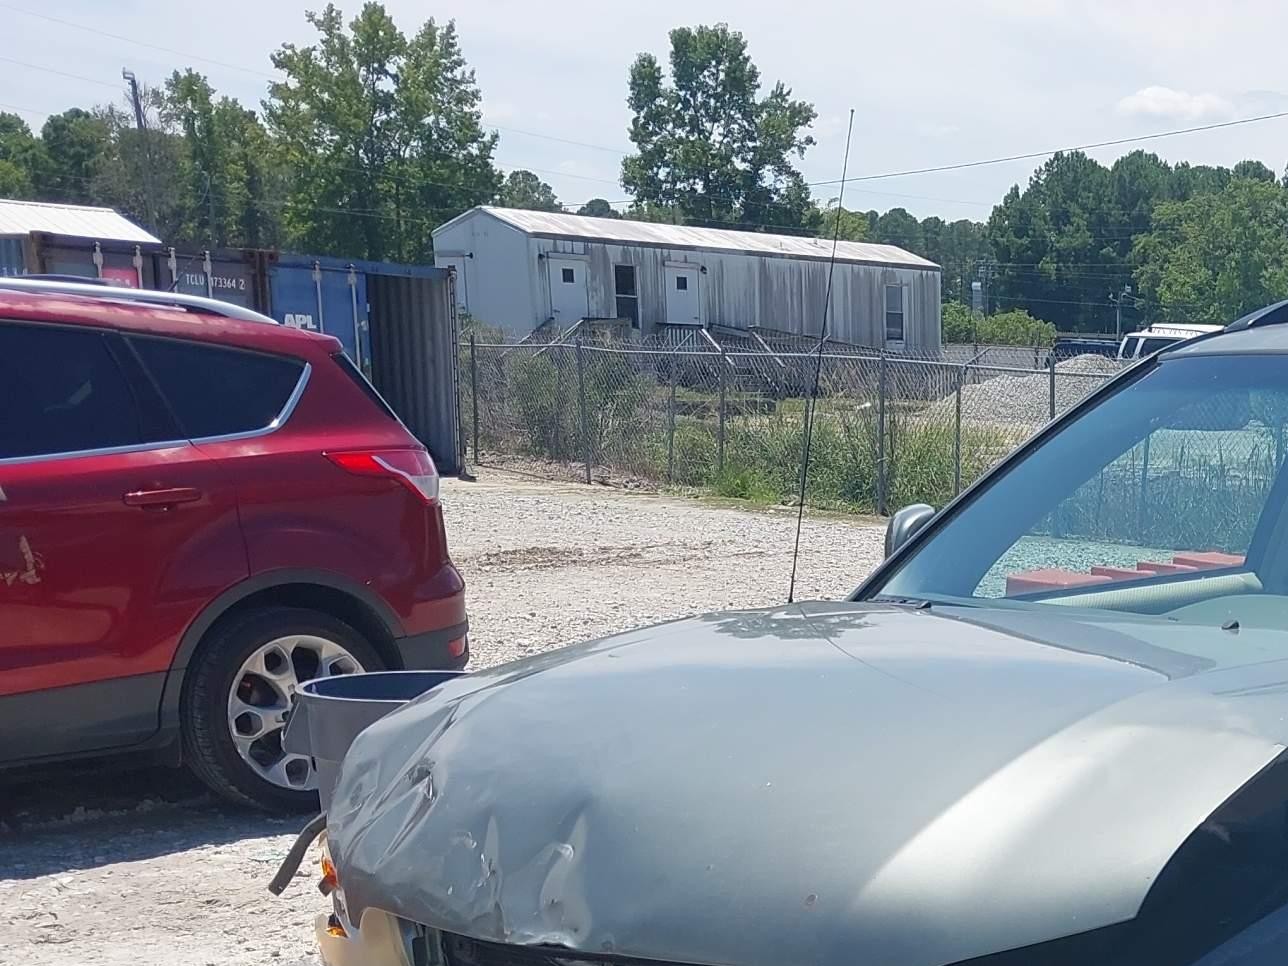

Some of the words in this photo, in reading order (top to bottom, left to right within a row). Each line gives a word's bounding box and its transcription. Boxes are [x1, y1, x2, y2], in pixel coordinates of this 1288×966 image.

[186, 273, 205, 286] TCLU
[239, 278, 246, 290] 2
[284, 313, 317, 329] APL
